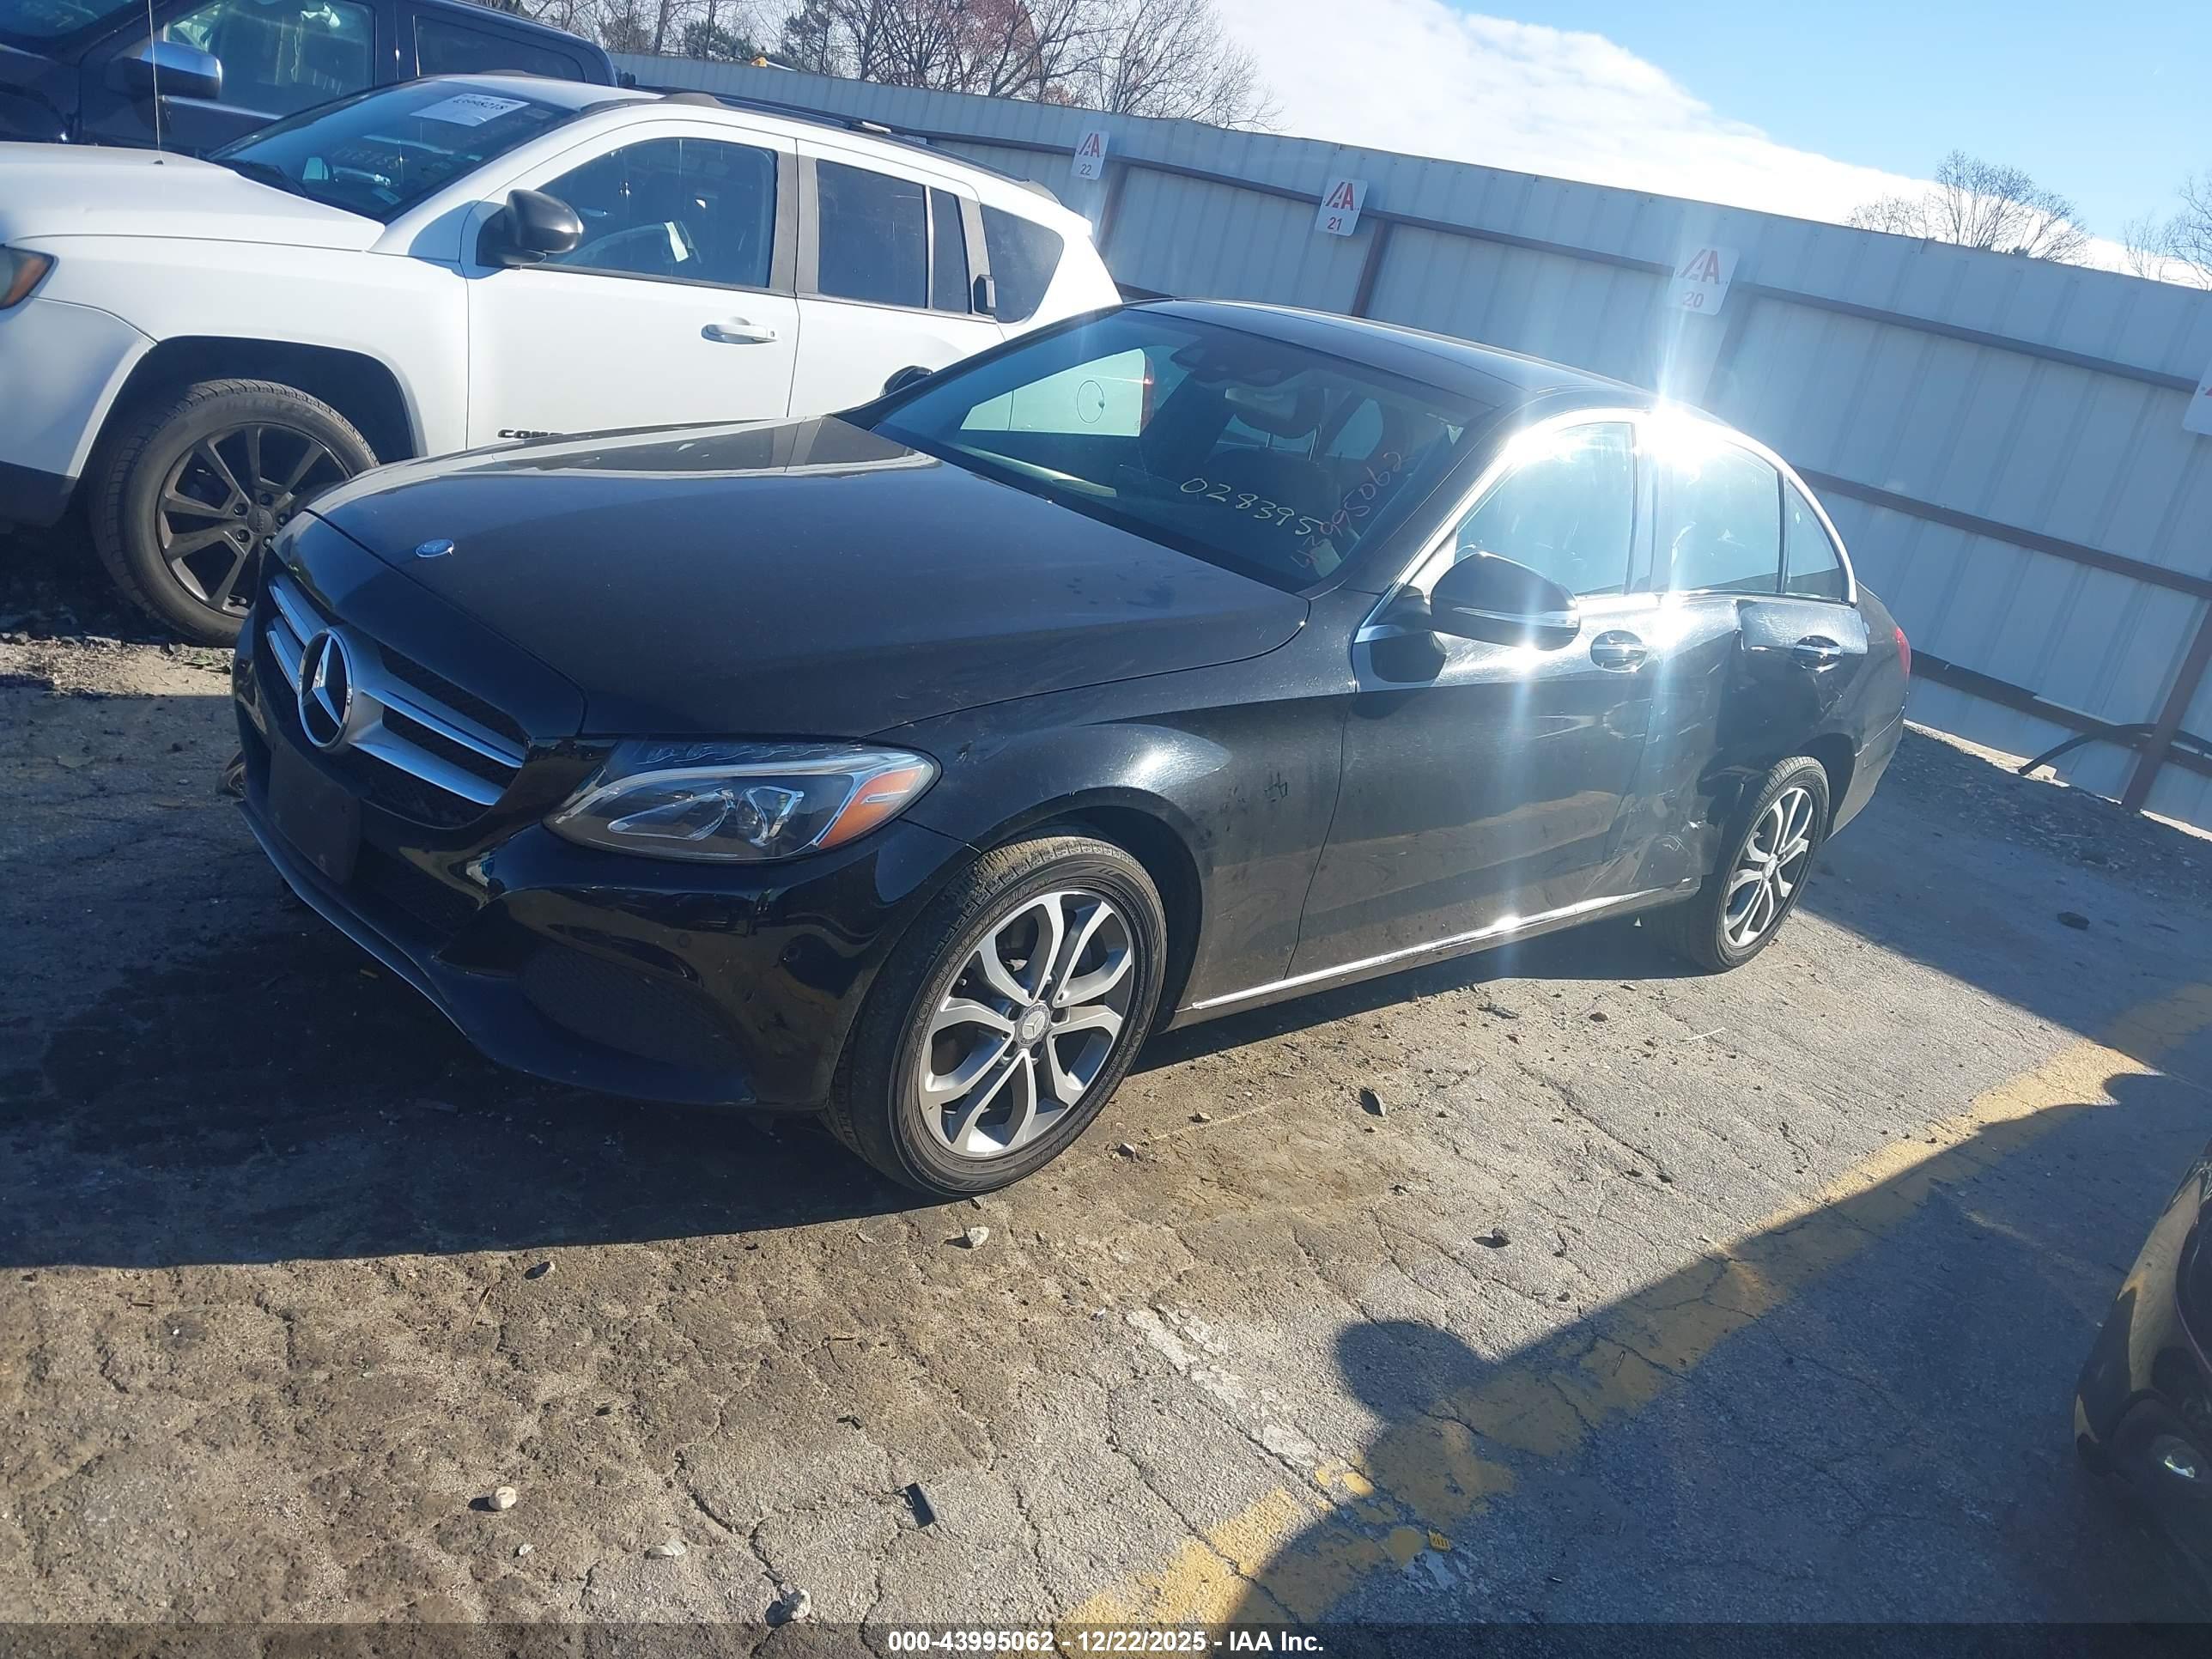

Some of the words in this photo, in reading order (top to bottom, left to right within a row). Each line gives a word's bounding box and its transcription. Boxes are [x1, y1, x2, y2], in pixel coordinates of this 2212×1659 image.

[1079, 163, 1092, 176] 22
[1327, 216, 1343, 232] 21
[1682, 291, 1705, 308] 20
[1180, 477, 1323, 536] 028395
[913, 930, 978, 1029] YOKOHAMA
